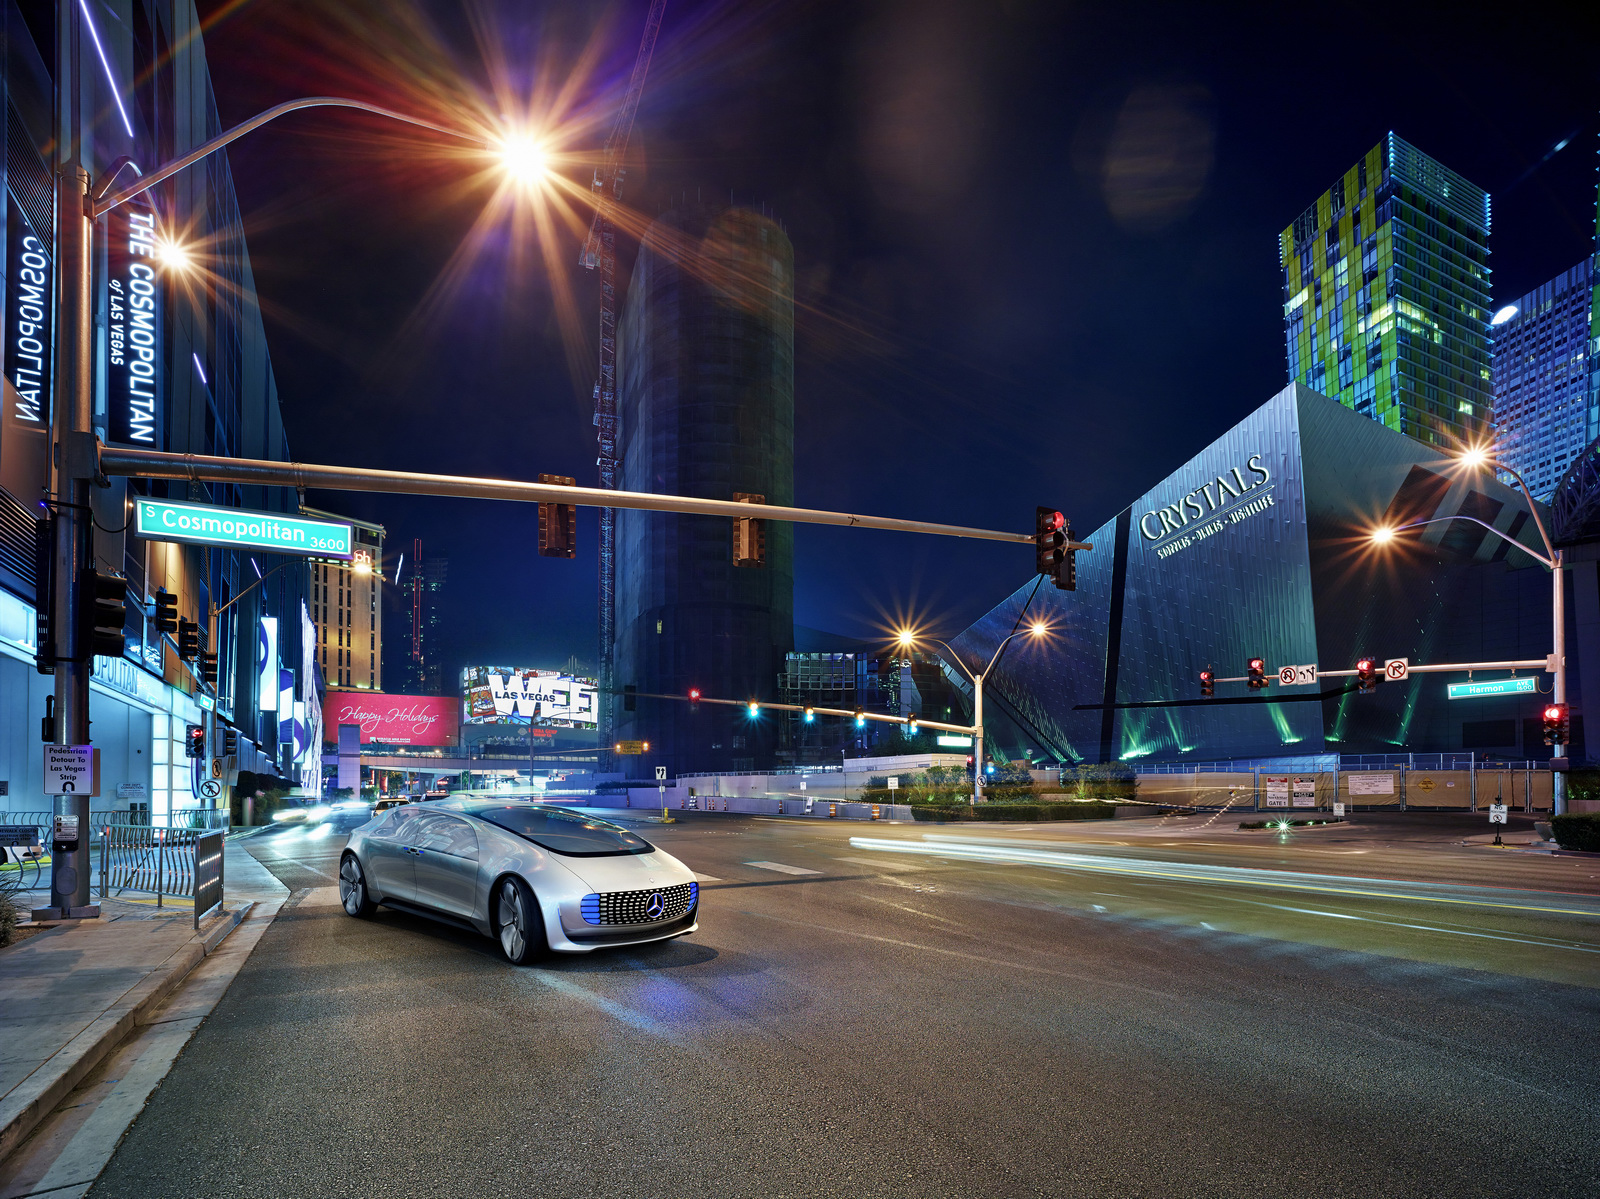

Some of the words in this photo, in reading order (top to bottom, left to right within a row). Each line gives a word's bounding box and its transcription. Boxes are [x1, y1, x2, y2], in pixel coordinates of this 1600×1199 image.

[129, 213, 154, 258] THE
[109, 279, 124, 295] of
[110, 295, 124, 321] LAS
[110, 324, 124, 366] VEGAS
[129, 263, 155, 442] COSMOPOLITAN
[1140, 454, 1270, 541] CRYSTALS
[146, 506, 156, 518] S
[162, 509, 305, 542] Cosmopolitan
[310, 536, 345, 551] 3600
[495, 691, 518, 700] LAS
[520, 693, 556, 703] VEGAS
[1469, 685, 1504, 694] Harmon
[338, 706, 381, 734] Happy
[385, 704, 439, 735] Holidays
[49, 747, 88, 755] Pedestrian
[60, 773, 77, 781] Strip
[64, 765, 86, 773] Vegas
[0, 787, 5, 795] 5
